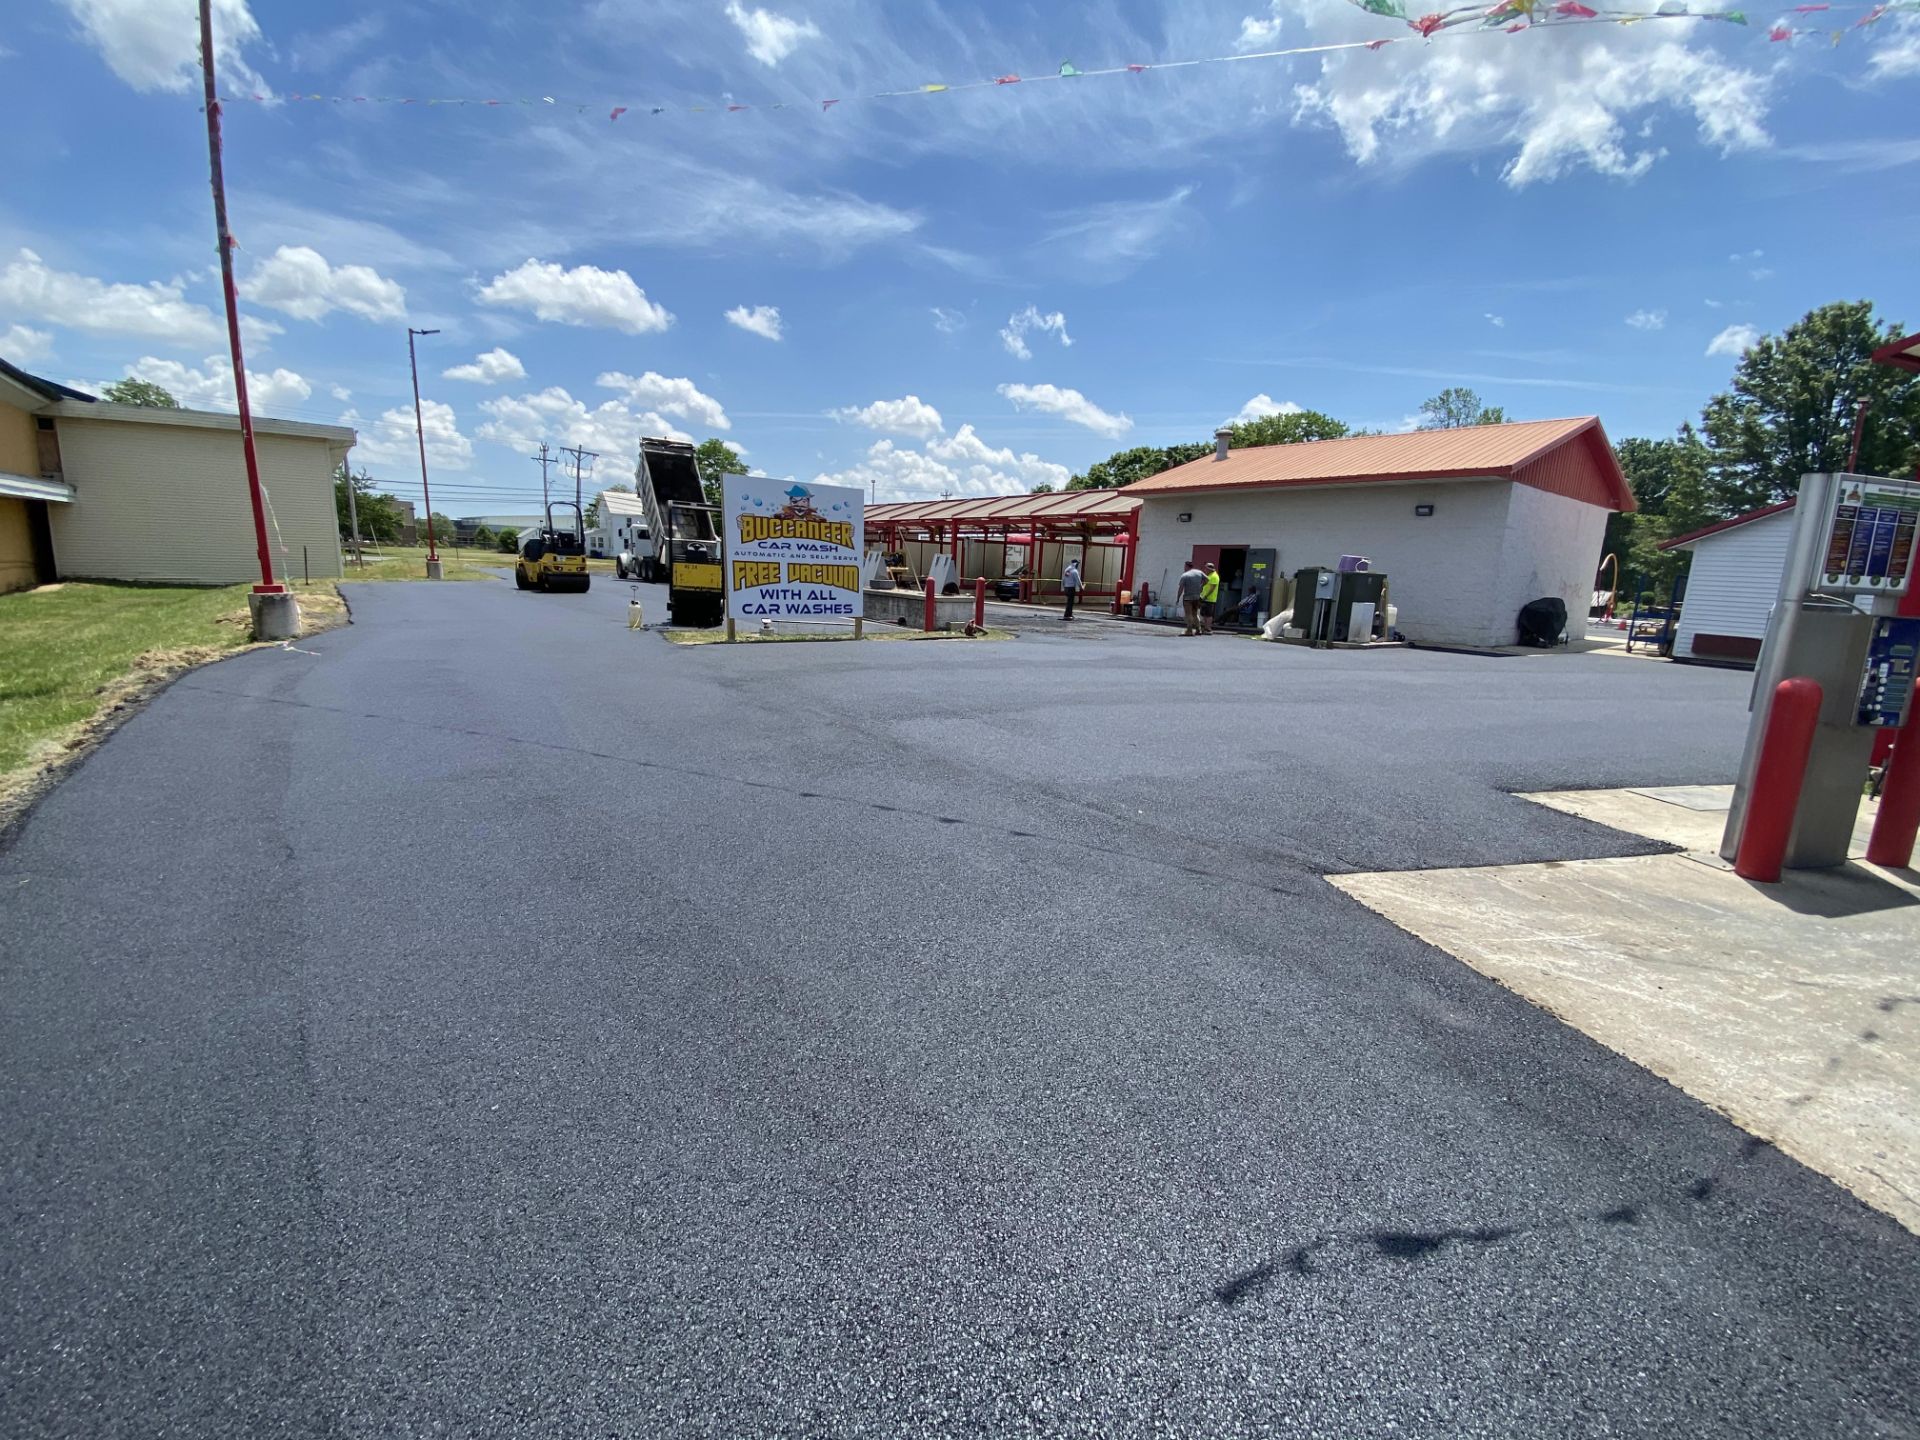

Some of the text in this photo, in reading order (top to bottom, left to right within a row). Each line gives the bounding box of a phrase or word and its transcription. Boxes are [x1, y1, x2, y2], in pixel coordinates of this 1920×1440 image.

[741, 515, 855, 550] BUCCANEER
[758, 541, 839, 552] CAR WASH
[732, 560, 860, 593] FREE VACUUM
[760, 589, 837, 600] WITH ALL
[742, 603, 853, 614] CAR WASHES
